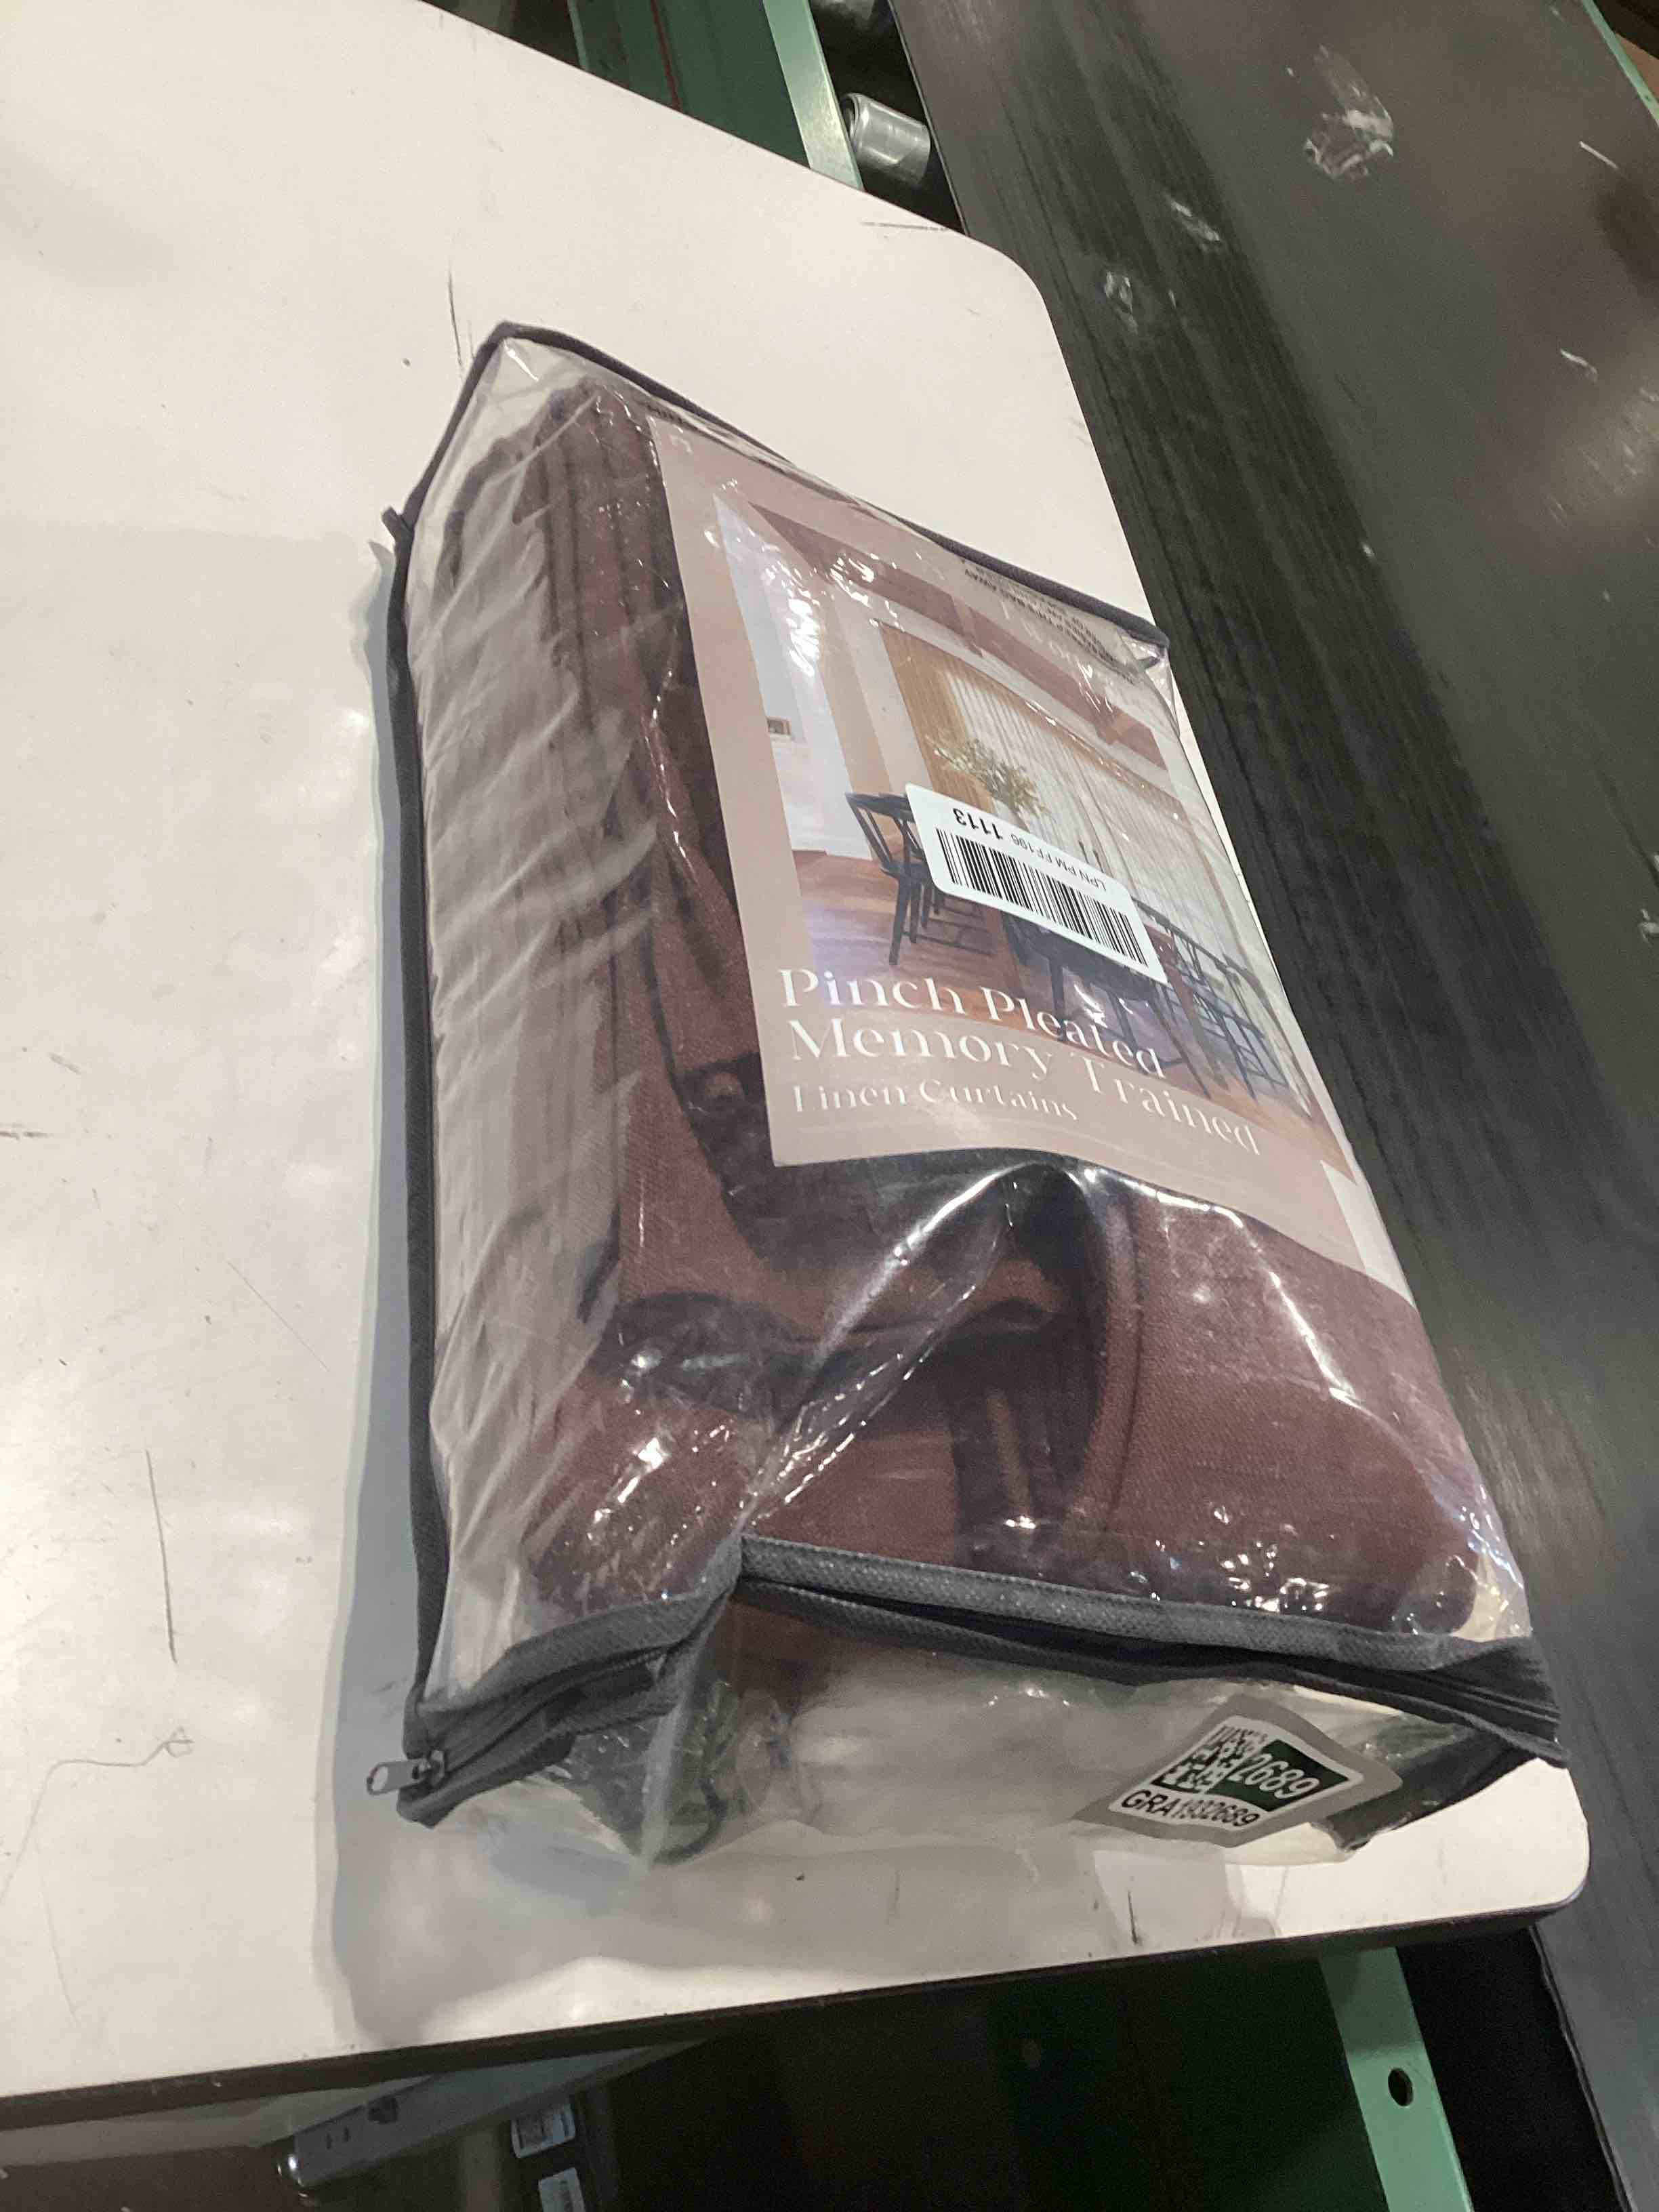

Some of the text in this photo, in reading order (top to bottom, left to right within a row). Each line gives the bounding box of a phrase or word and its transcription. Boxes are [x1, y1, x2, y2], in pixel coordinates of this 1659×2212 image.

[952, 807, 1004, 840] 1113
[779, 968, 1166, 1080] Pinch Pleated
[787, 1017, 1261, 1156] Memory Trained
[919, 1078, 1078, 1121] Curtains
[1227, 1753, 1321, 1800] 2689
